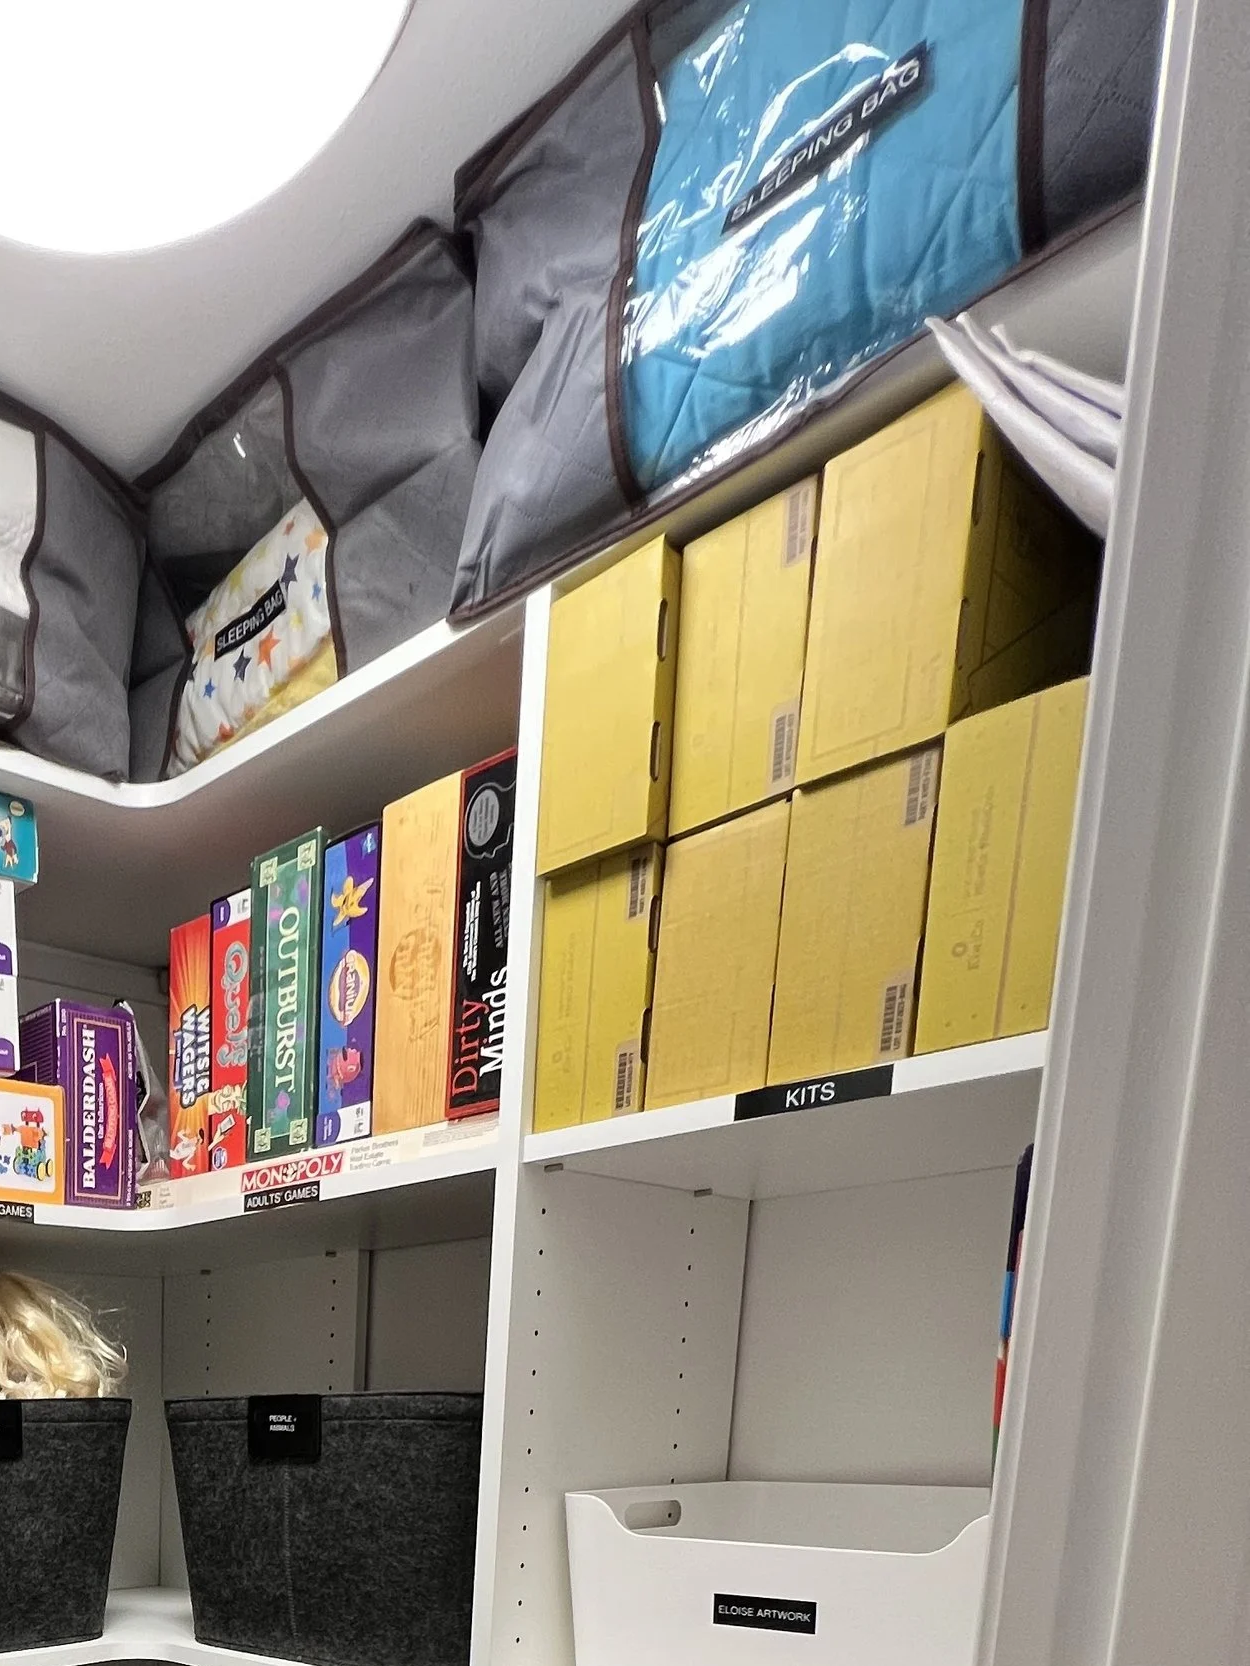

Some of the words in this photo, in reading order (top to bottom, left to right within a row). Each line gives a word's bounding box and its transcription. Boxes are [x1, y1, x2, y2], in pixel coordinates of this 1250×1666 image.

[730, 113, 853, 223] SLEEPING
[860, 62, 921, 119] BAG
[216, 606, 265, 653] SLEEPING
[263, 588, 284, 617] BAG
[274, 905, 301, 1090] OUTBURST
[478, 968, 509, 1078] Minds
[181, 1006, 196, 1108] WAGERS
[196, 1008, 211, 1070] WITS
[451, 998, 490, 1097] Dirty
[82, 1029, 96, 1190] BALDERDASH
[784, 1080, 837, 1108] KITS
[241, 1152, 344, 1192] MONOPOLY
[246, 1193, 282, 1209] ADULTS'
[283, 1185, 319, 1202] GAMES
[268, 1414, 293, 1423] PEOPLE
[269, 1424, 296, 1433] ANIMALS
[717, 1604, 755, 1618] ELOISE
[756, 1608, 812, 1623] ARTWORK
